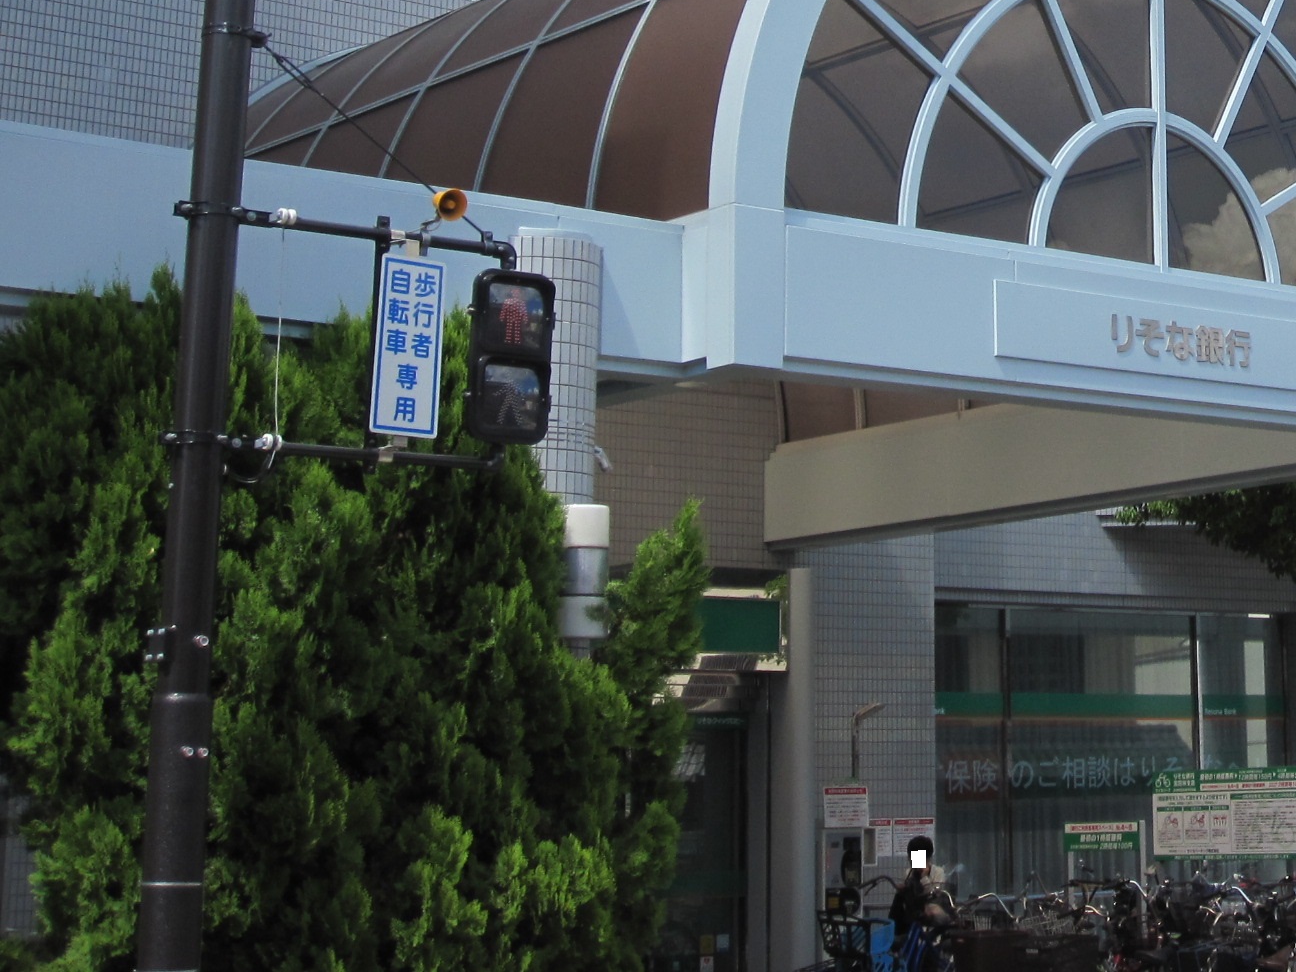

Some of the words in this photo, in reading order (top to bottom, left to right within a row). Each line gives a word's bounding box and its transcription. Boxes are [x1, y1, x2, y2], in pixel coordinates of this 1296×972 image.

[385, 269, 411, 356] 自転車
[410, 272, 436, 359] 歩行者
[1110, 313, 1252, 368] りそな銀行
[393, 363, 418, 423] 専用
